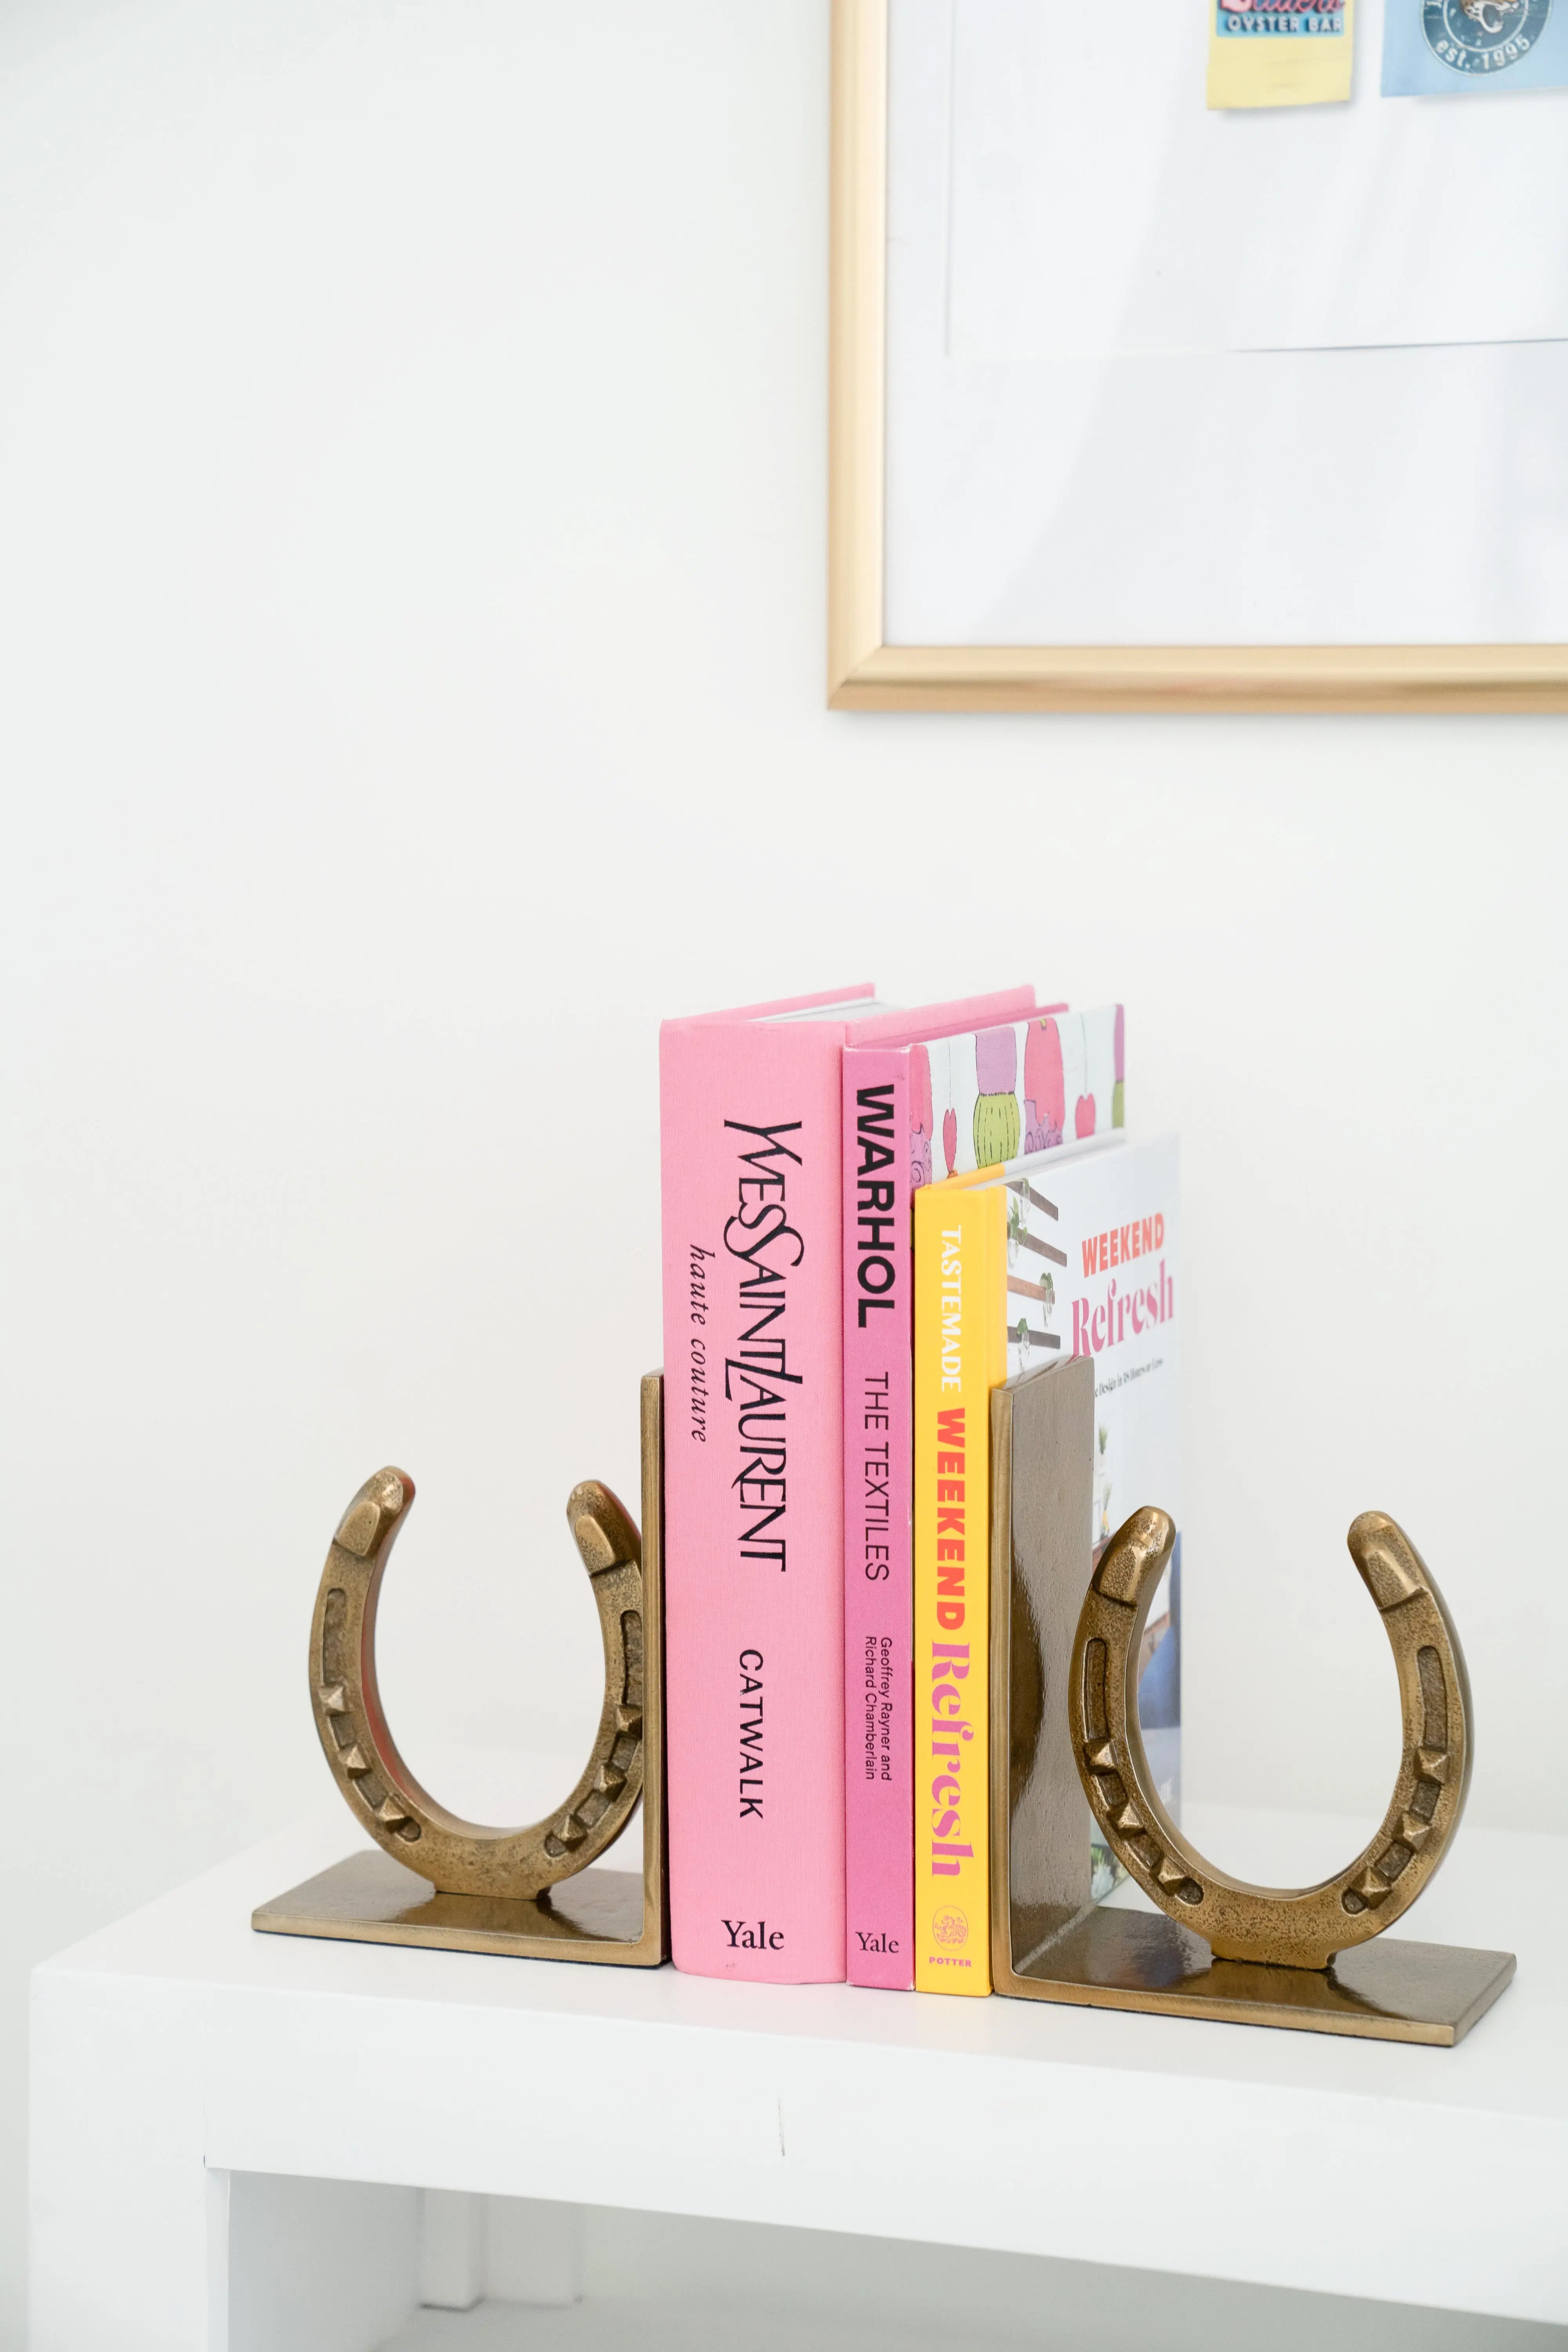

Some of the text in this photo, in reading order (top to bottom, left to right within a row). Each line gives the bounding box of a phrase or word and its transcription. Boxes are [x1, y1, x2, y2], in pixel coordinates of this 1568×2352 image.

[1227, 15, 1341, 32] OYSTER BAR
[1436, 34, 1530, 69] est. 1995
[857, 1084, 895, 1328] WARHOL
[1082, 1212, 1165, 1278] WEEKEND
[690, 1245, 715, 1442] haute couture
[1071, 1258, 1175, 1357] Refresh
[865, 1372, 889, 1581] THE TEXTILES
[932, 1225, 974, 1876] TASTEMADE WEEKEND Refresh
[739, 1650, 764, 1818] CATWALK
[865, 1636, 877, 1780] Richard Chamberlain
[878, 1637, 893, 1781] Geoffrey Rayner and
[721, 1920, 784, 1950] Yale
[856, 1932, 899, 1953] Yale
[929, 1956, 972, 1967] POTTER
